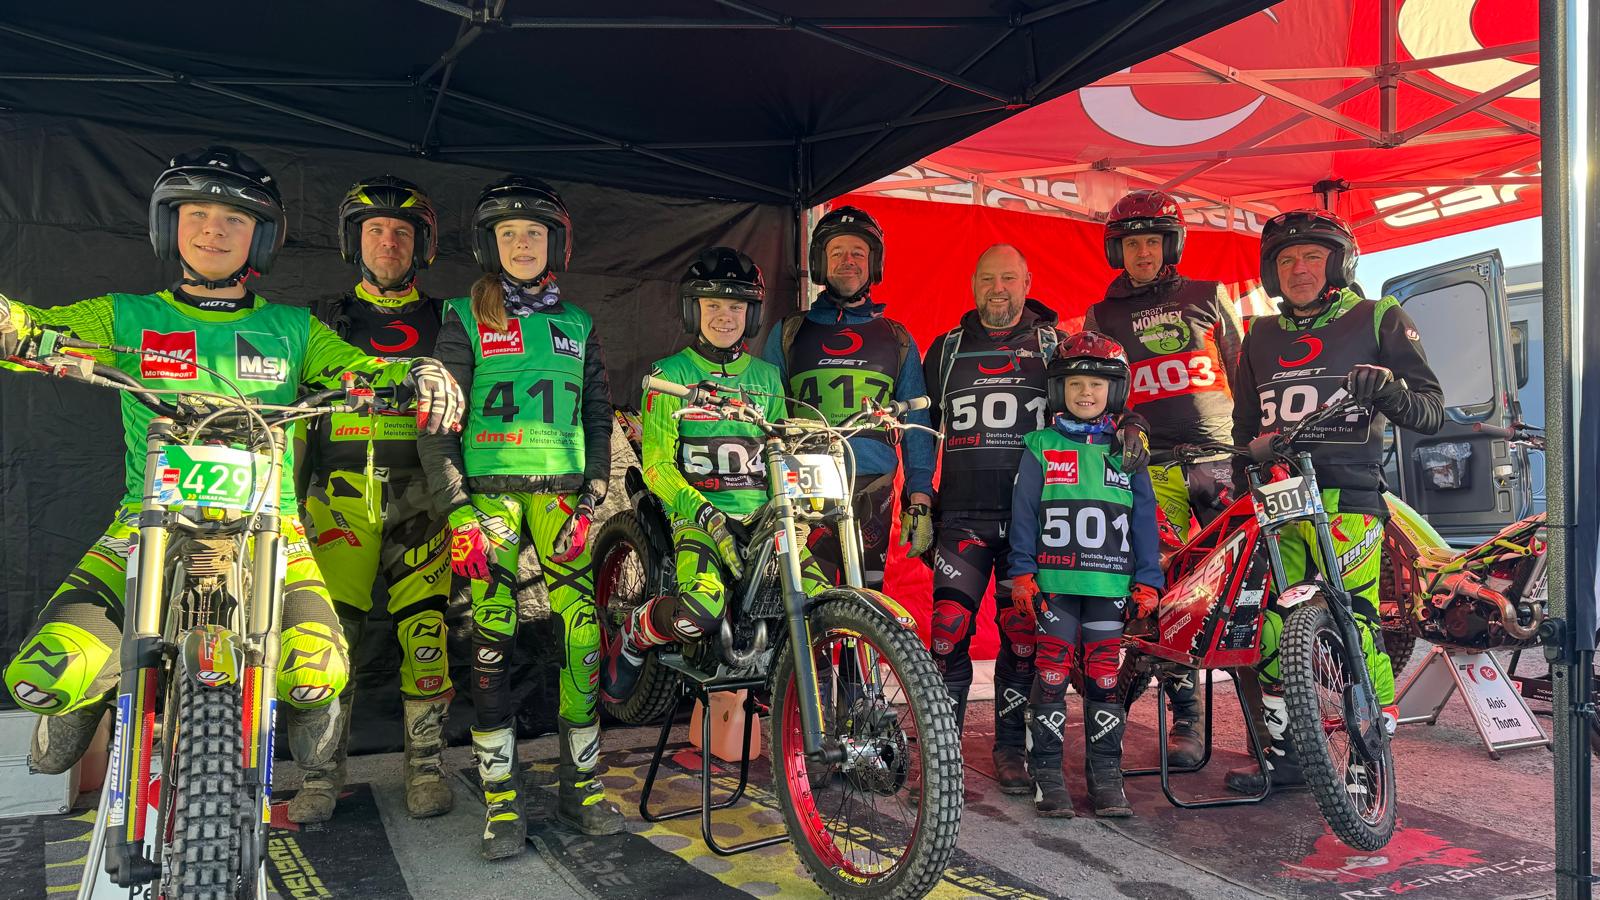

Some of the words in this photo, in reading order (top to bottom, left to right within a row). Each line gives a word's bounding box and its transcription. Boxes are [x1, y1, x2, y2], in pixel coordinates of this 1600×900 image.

[199, 300, 237, 308] MOTS
[1132, 311, 1183, 333] MONKEY
[482, 331, 519, 344] DMV
[817, 358, 868, 366] OSET
[144, 370, 194, 378] MOTORSPORT
[972, 377, 1027, 385] OSET
[1133, 356, 1217, 395] 403
[1271, 367, 1327, 380] OSET
[797, 375, 890, 409] 417
[482, 379, 581, 427] 417
[951, 392, 1049, 431] 501
[476, 428, 524, 445] dmsj
[948, 433, 981, 447] dmsj
[1047, 461, 1075, 474] DMV
[182, 463, 250, 497] 429
[799, 467, 823, 489] 50
[1265, 489, 1302, 515] 501
[1041, 507, 1130, 553] 501
[1037, 552, 1077, 567] dmsj
[1486, 697, 1507, 710] Alois
[1090, 716, 1121, 743] hebo
[1492, 717, 1521, 731] Thoma
[111, 707, 124, 791] MICHELIN
